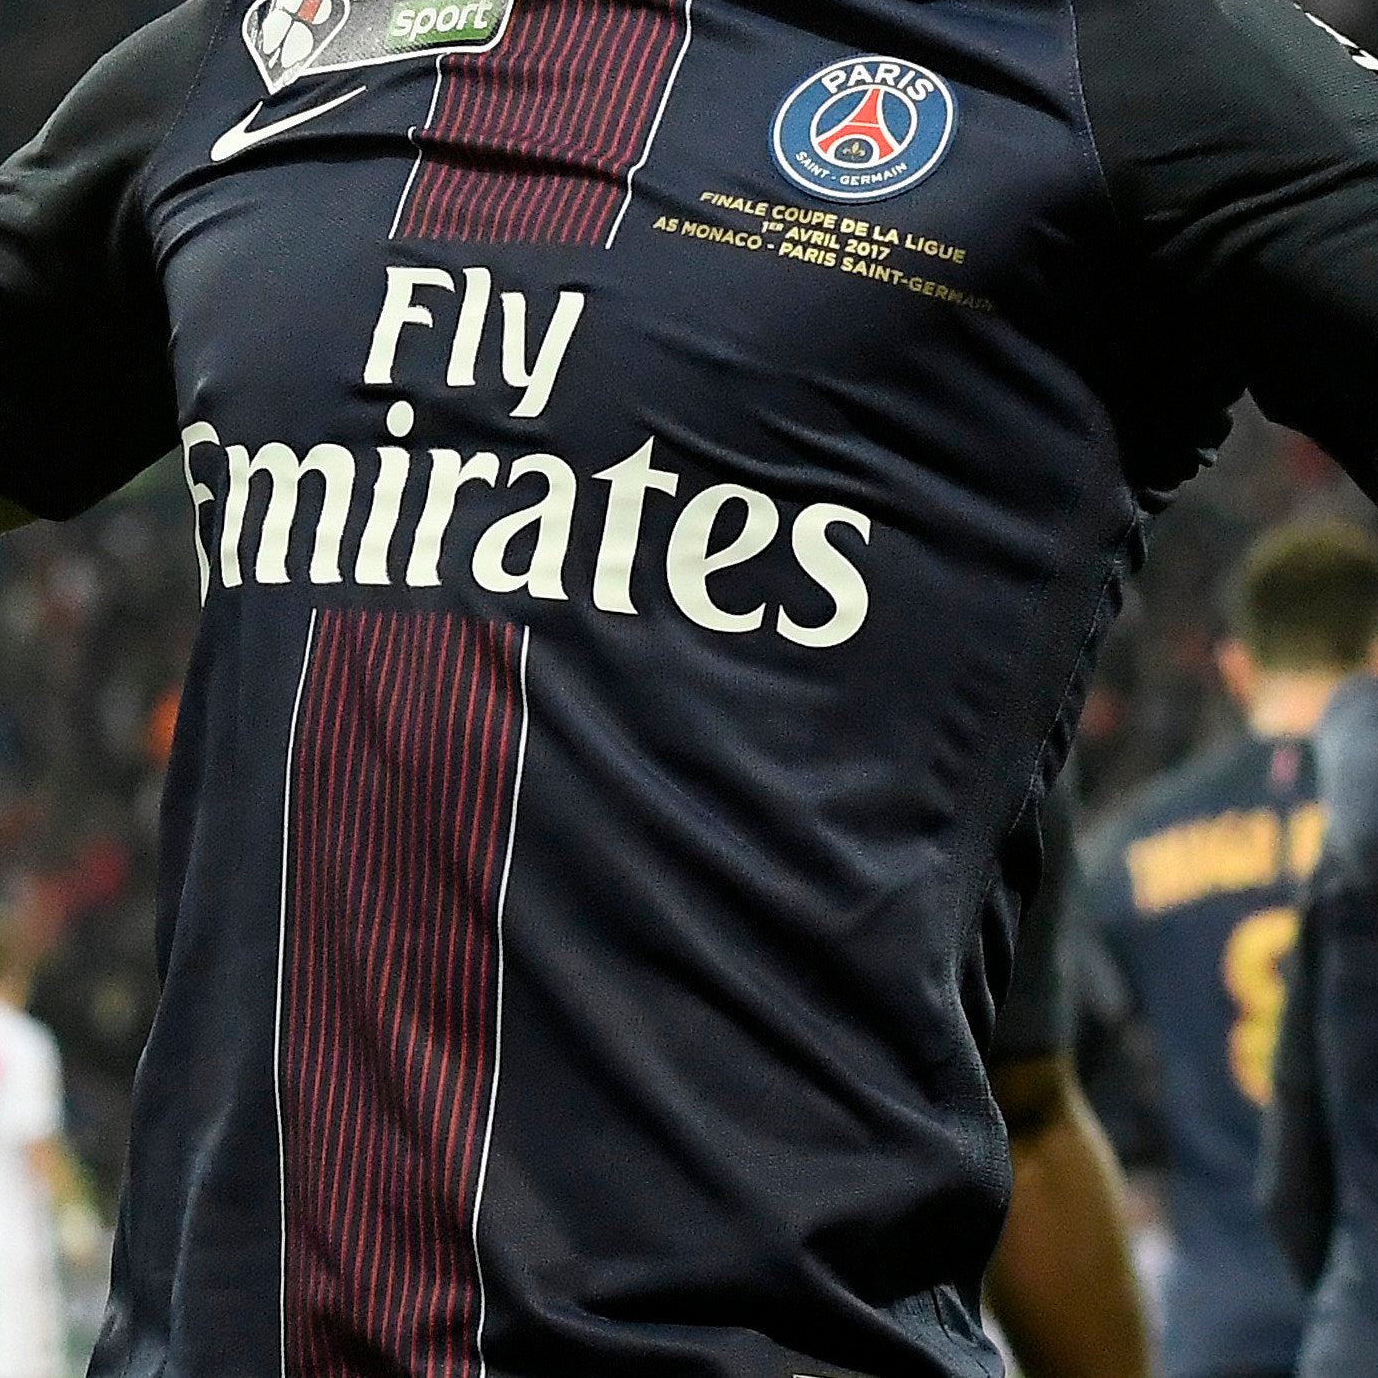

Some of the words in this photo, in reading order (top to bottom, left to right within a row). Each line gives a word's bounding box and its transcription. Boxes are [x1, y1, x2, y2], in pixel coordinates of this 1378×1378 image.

[821, 63, 934, 101] PARIS
[795, 151, 830, 179] SAINT
[839, 162, 908, 186] GERMAIN
[653, 216, 679, 233] AS
[681, 221, 763, 250] MONACO
[778, 242, 837, 268] PARIS
[699, 191, 769, 217] FINALE
[772, 205, 838, 230] COUPE
[840, 218, 869, 237] DE
[873, 225, 900, 246] LA
[904, 233, 967, 265] LIGUE
[785, 226, 841, 251] AVRIL
[844, 239, 892, 261] 2017
[363, 266, 585, 418] Fly
